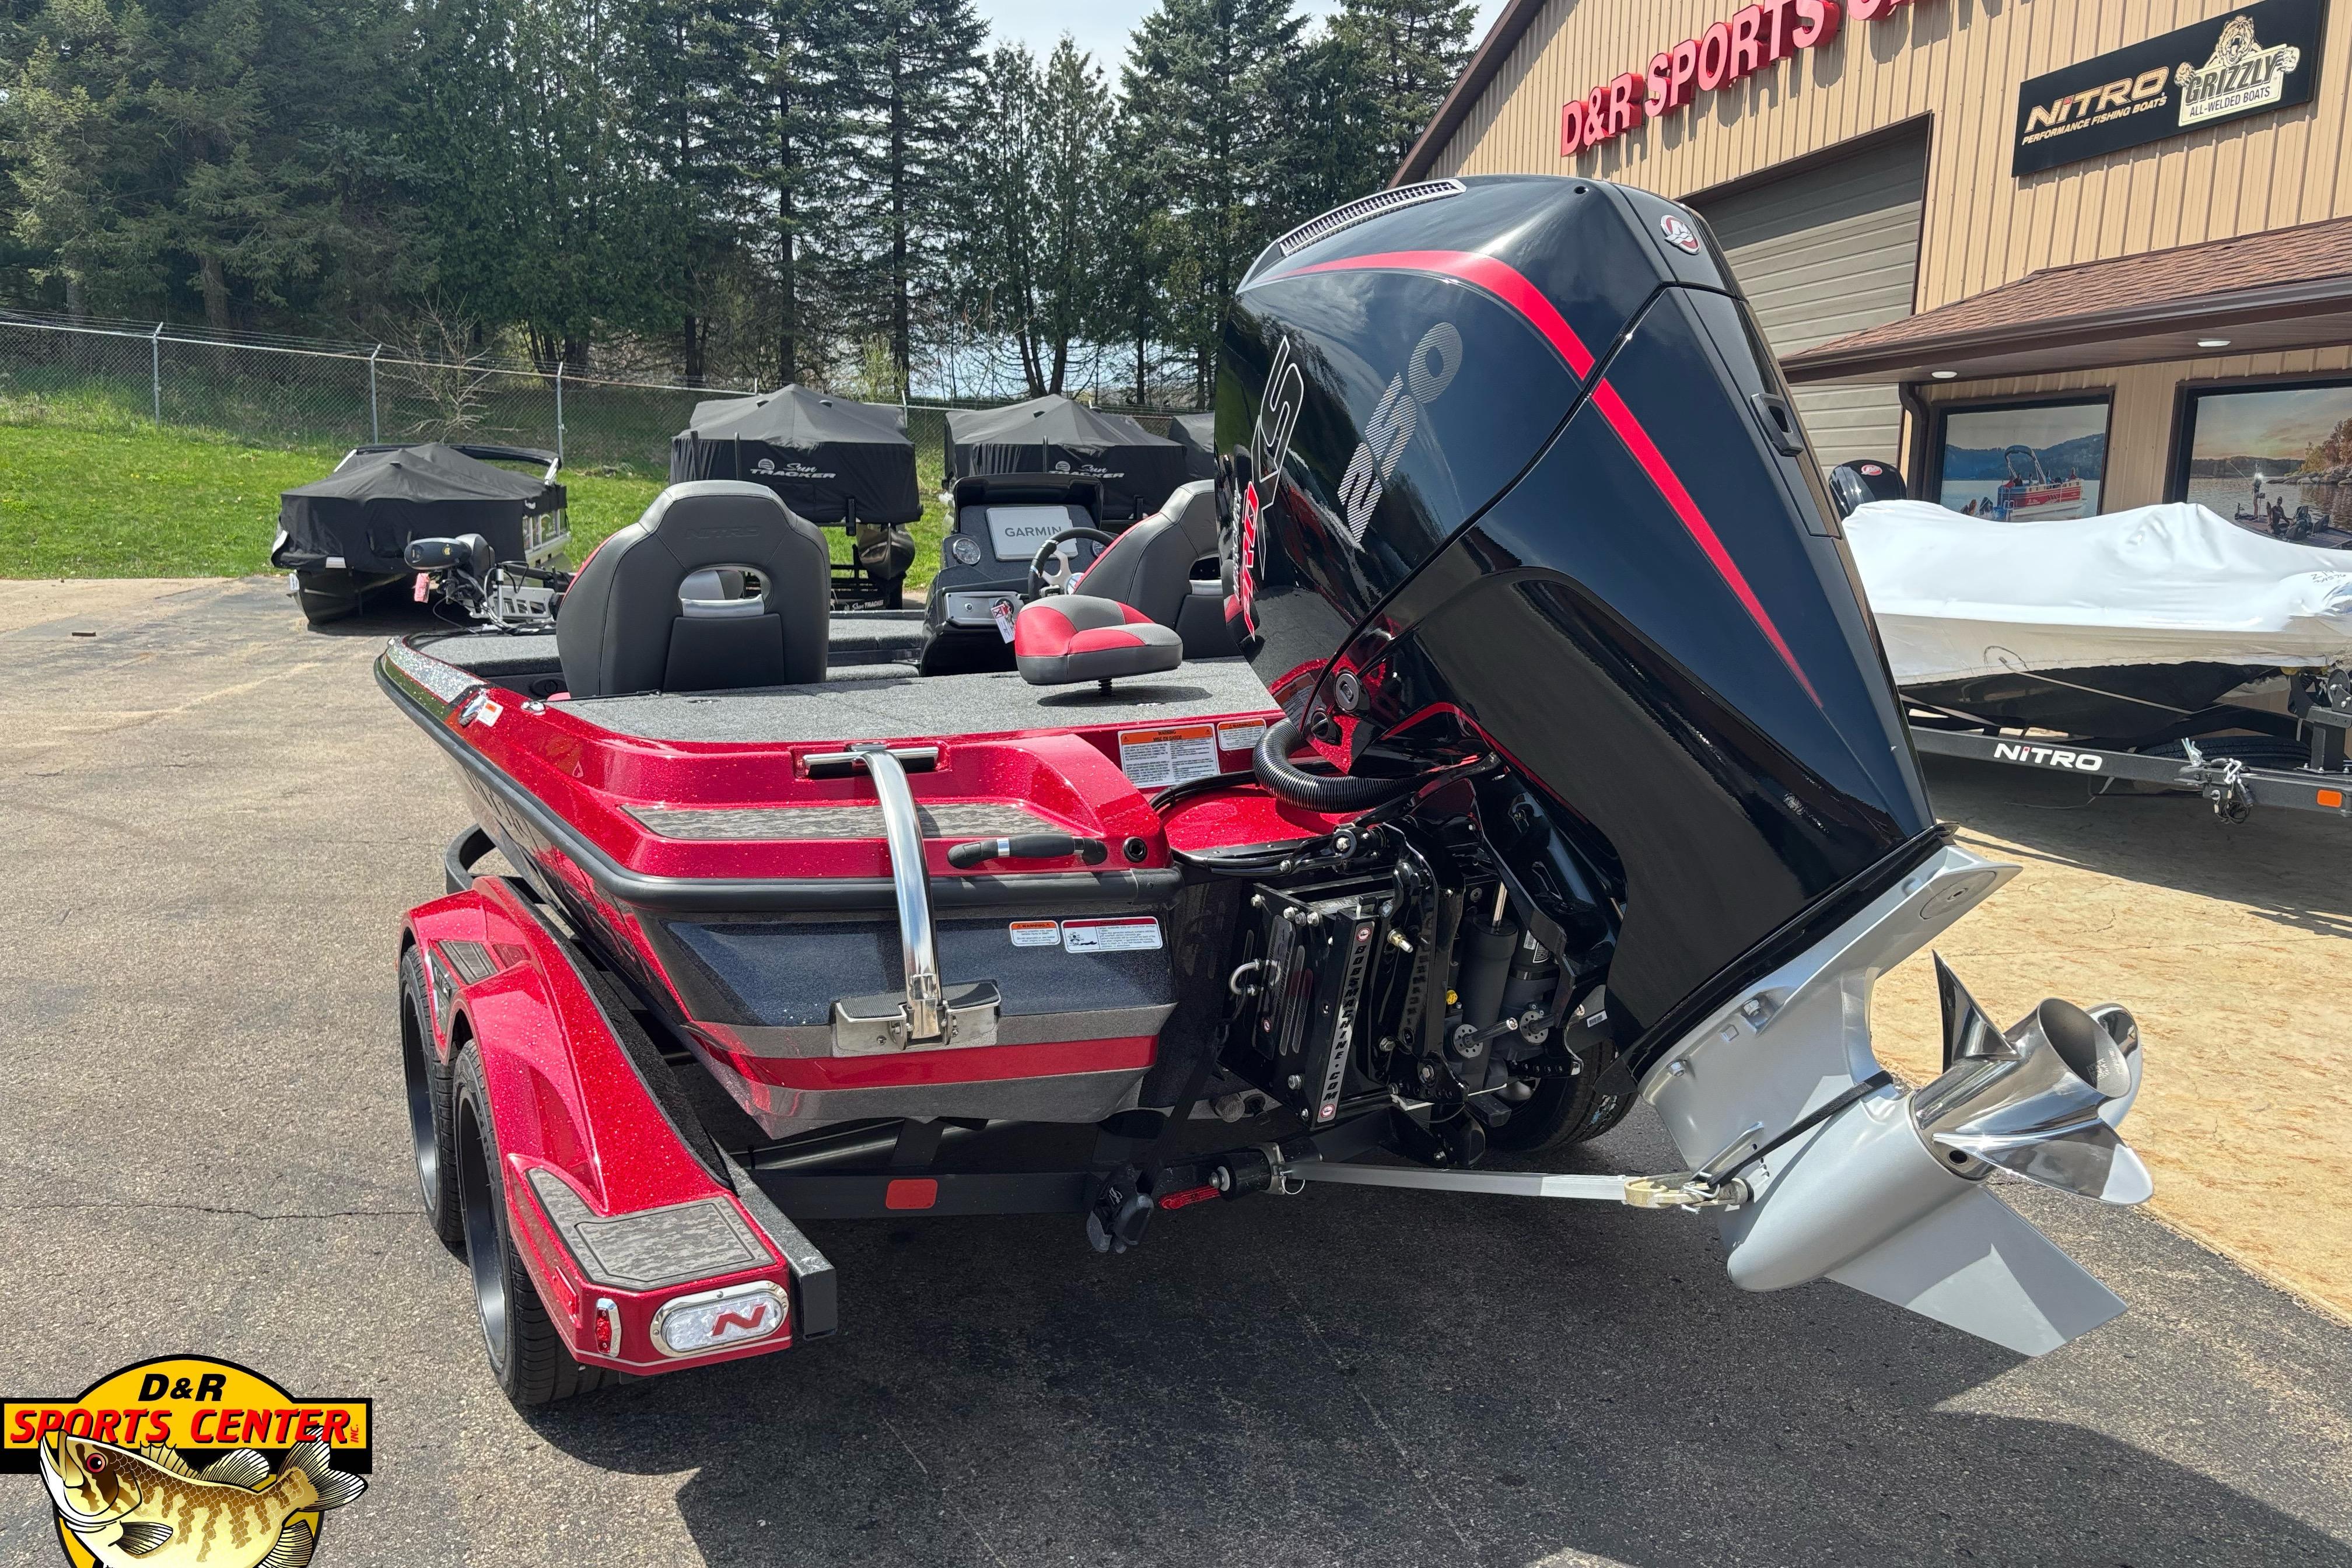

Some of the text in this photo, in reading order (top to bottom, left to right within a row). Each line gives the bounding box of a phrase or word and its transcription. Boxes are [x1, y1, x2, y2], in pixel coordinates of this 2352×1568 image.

[1562, 0, 1836, 158] D&R SPORTS
[2186, 54, 2278, 106] GRIZZLY
[2021, 96, 2168, 145] PERFORMANCE FISHING BOATS
[2190, 86, 2270, 117] ALL-WELDED BOATS
[1337, 322, 1462, 543] 250
[750, 468, 836, 478] TRACKER
[1005, 526, 1061, 537] GARMIN
[1994, 743, 2102, 771] NITRO
